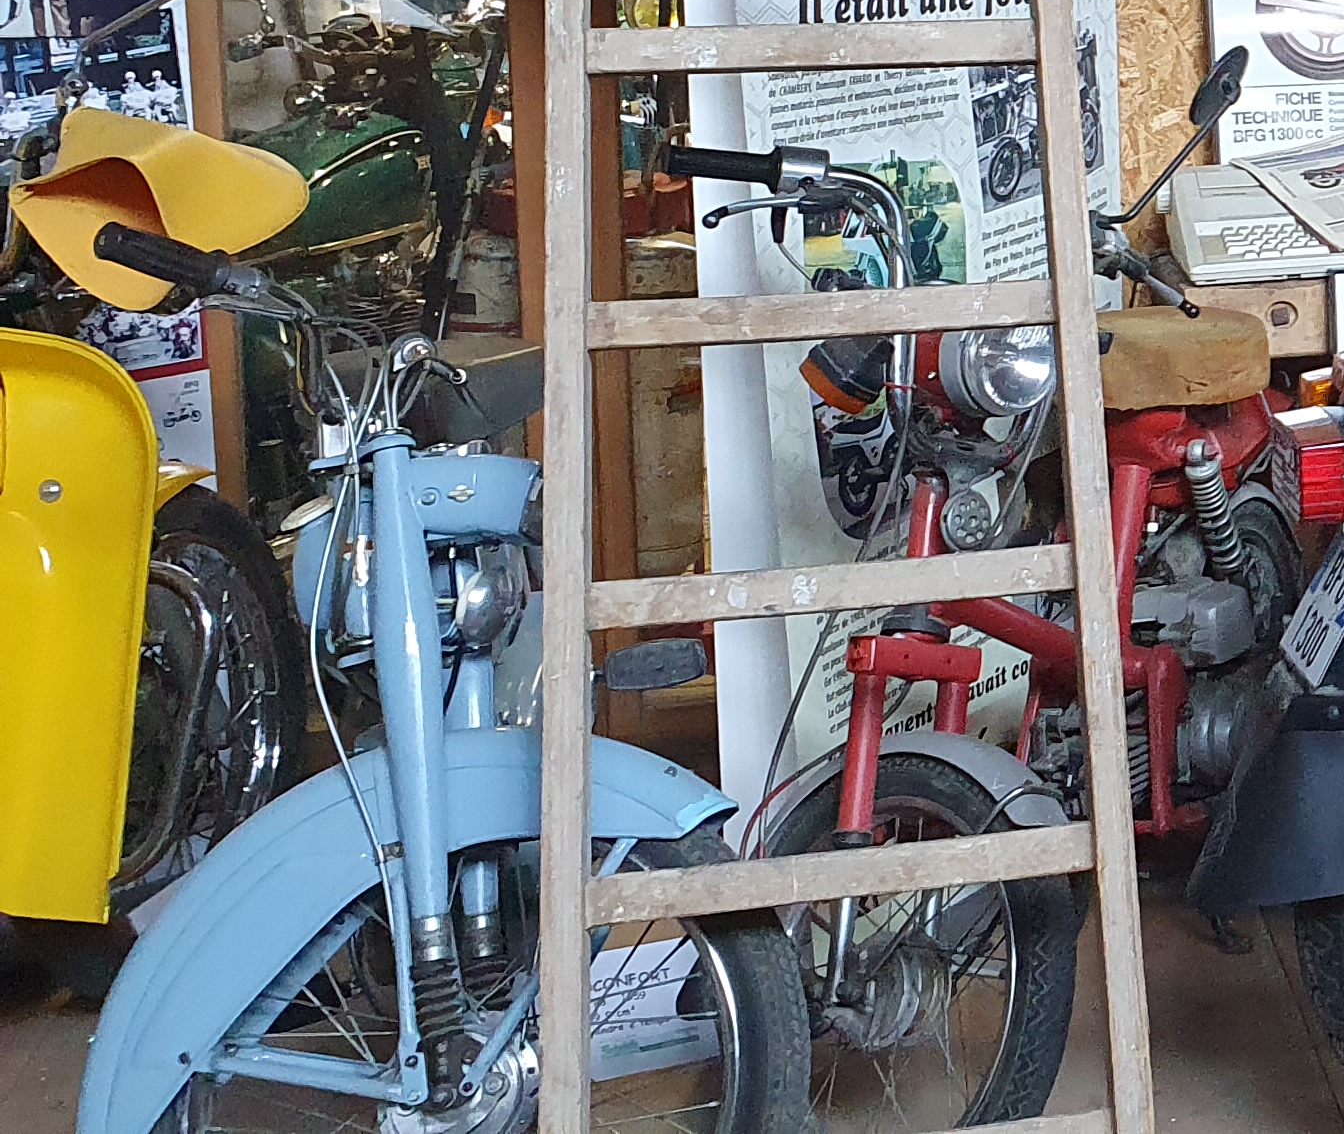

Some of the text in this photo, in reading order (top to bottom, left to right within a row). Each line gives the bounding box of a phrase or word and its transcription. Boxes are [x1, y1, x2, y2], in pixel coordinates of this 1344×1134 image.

[1275, 91, 1322, 106] FICHE
[1232, 108, 1324, 125] TECHNIQUE
[1290, 604, 1329, 667] 1300
